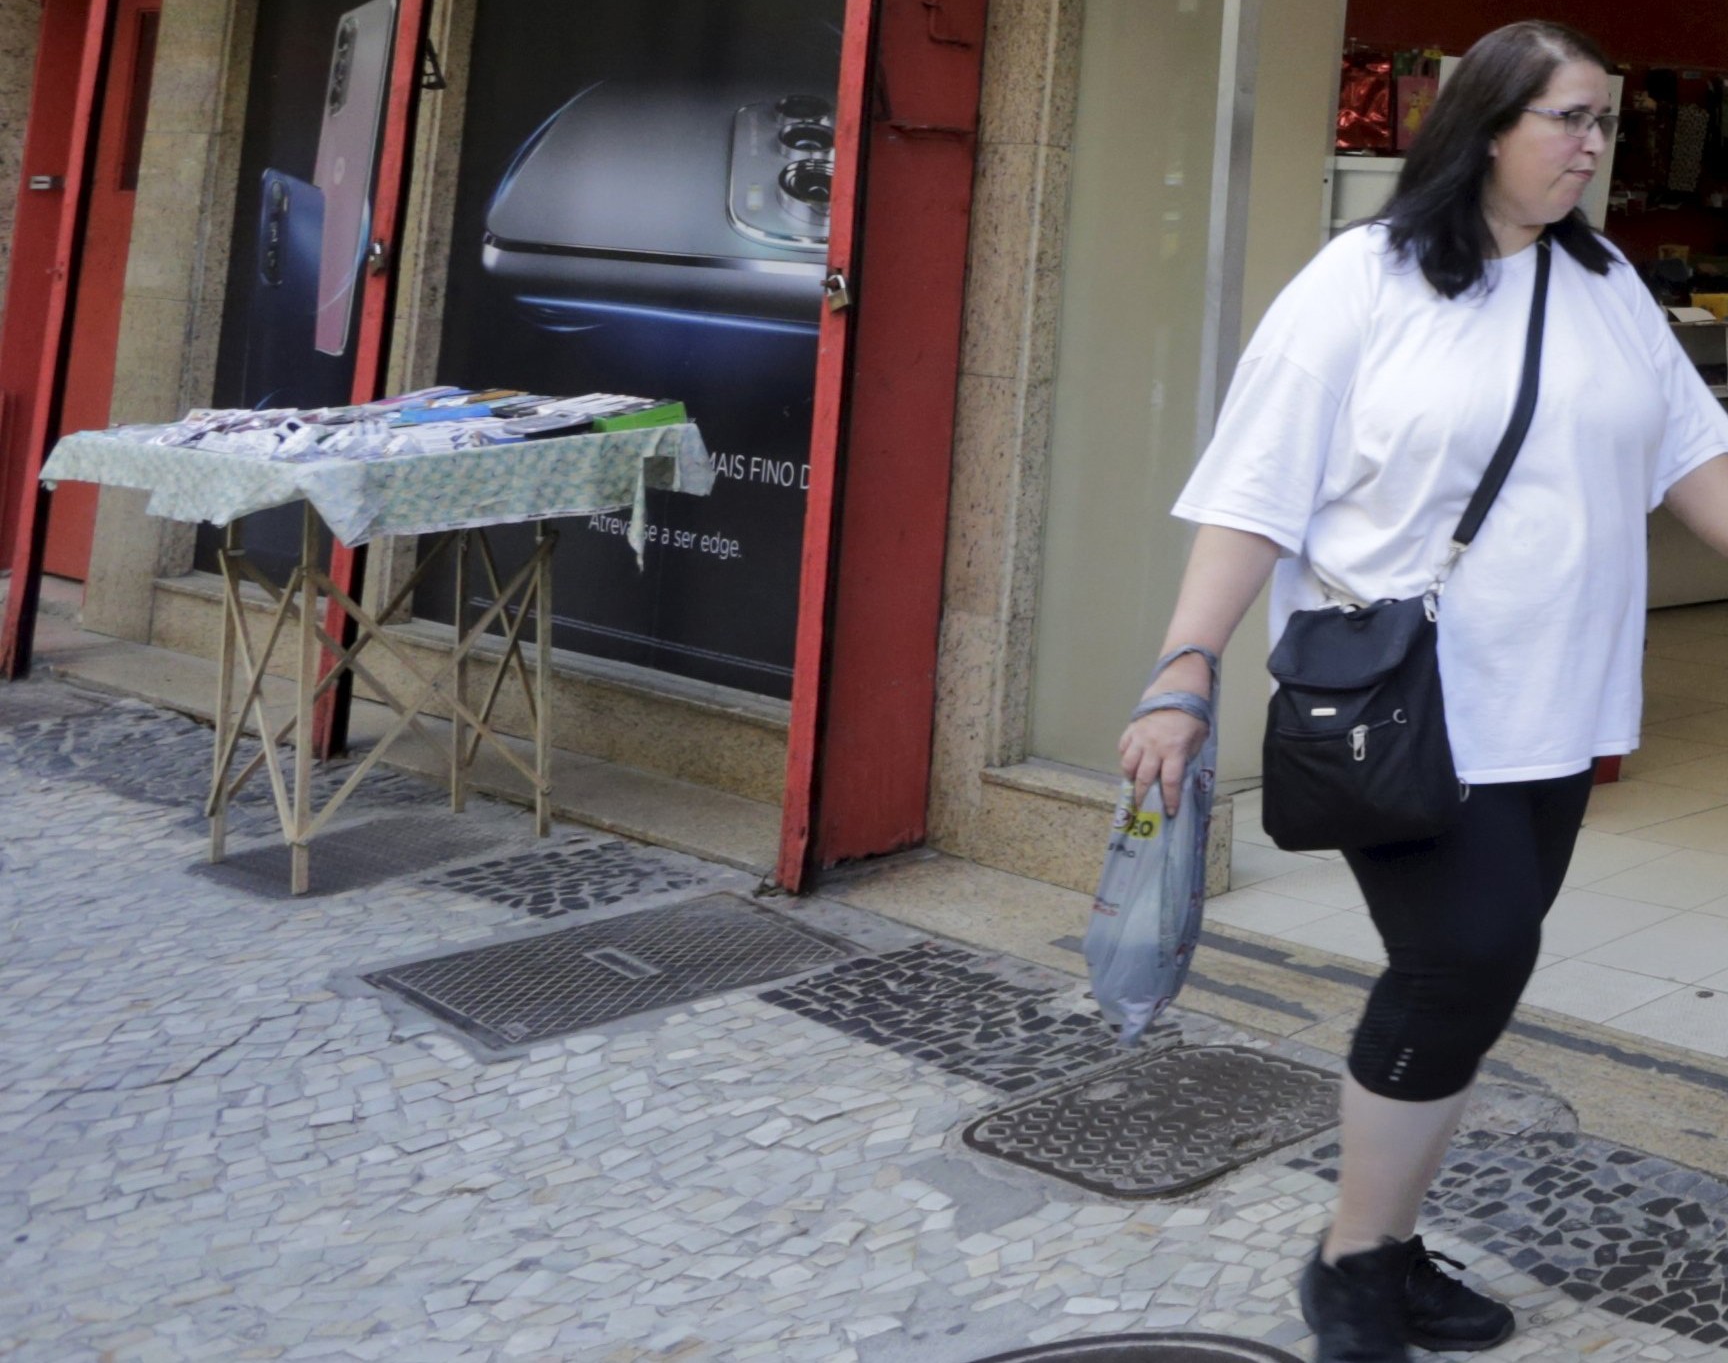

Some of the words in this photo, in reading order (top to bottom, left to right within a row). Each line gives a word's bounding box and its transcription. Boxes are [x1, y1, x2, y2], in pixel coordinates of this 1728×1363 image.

[750, 457, 794, 487] FINO
[661, 527, 669, 544] a
[674, 529, 696, 549] ser
[700, 531, 742, 560] edge.
